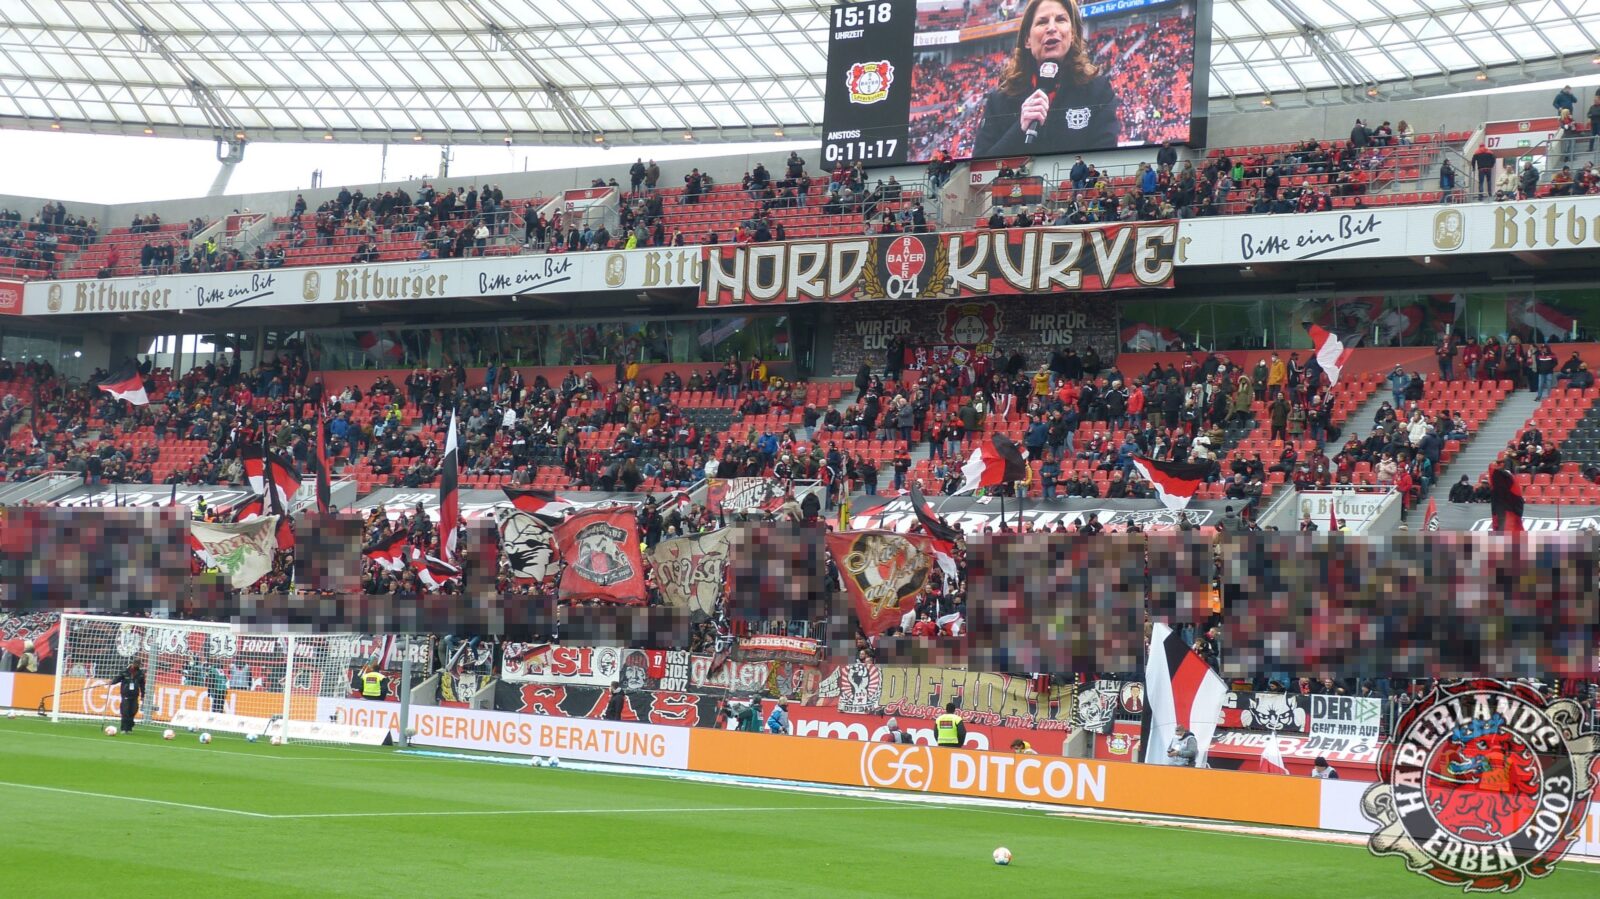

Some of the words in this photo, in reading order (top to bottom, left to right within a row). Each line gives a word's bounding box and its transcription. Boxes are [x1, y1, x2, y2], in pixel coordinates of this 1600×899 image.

[834, 3, 892, 28] 15:18
[835, 30, 864, 40] UHRZEIT
[827, 130, 861, 140] ANSTOSS
[1487, 137, 1500, 148] D7
[825, 139, 897, 162] 0:11:17
[1241, 233, 1290, 260] Bitte
[1296, 229, 1334, 248] ein
[1339, 213, 1382, 239] Bit
[705, 239, 870, 303] NORD
[947, 224, 1179, 293] KURVE
[887, 253, 924, 263] BAYER
[334, 268, 449, 301] Bitburger
[479, 272, 512, 294] Bitte
[515, 269, 541, 284] ein
[544, 257, 573, 278] Bit
[886, 273, 920, 299] 04
[73, 281, 172, 312] Bitburger
[197, 286, 225, 306] Bitte
[227, 283, 250, 298] ein
[251, 274, 276, 292] Bit
[856, 320, 884, 336] WIR
[884, 317, 912, 336] FÜR
[1030, 314, 1056, 330] IHR
[1056, 311, 1087, 329] FÜR
[1041, 328, 1073, 345] UNS
[242, 639, 275, 652] FORZA
[659, 678, 687, 692] BOYZ
[1313, 695, 1353, 721] DER
[334, 706, 532, 747] DIGITAISIERUNGS
[539, 725, 665, 758] BERATUNG
[1311, 722, 1336, 735] GEHT
[1338, 723, 1357, 736] MIR
[1358, 725, 1378, 737] AUF
[1303, 735, 1349, 751] DEN
[949, 752, 1106, 802] DITCON
